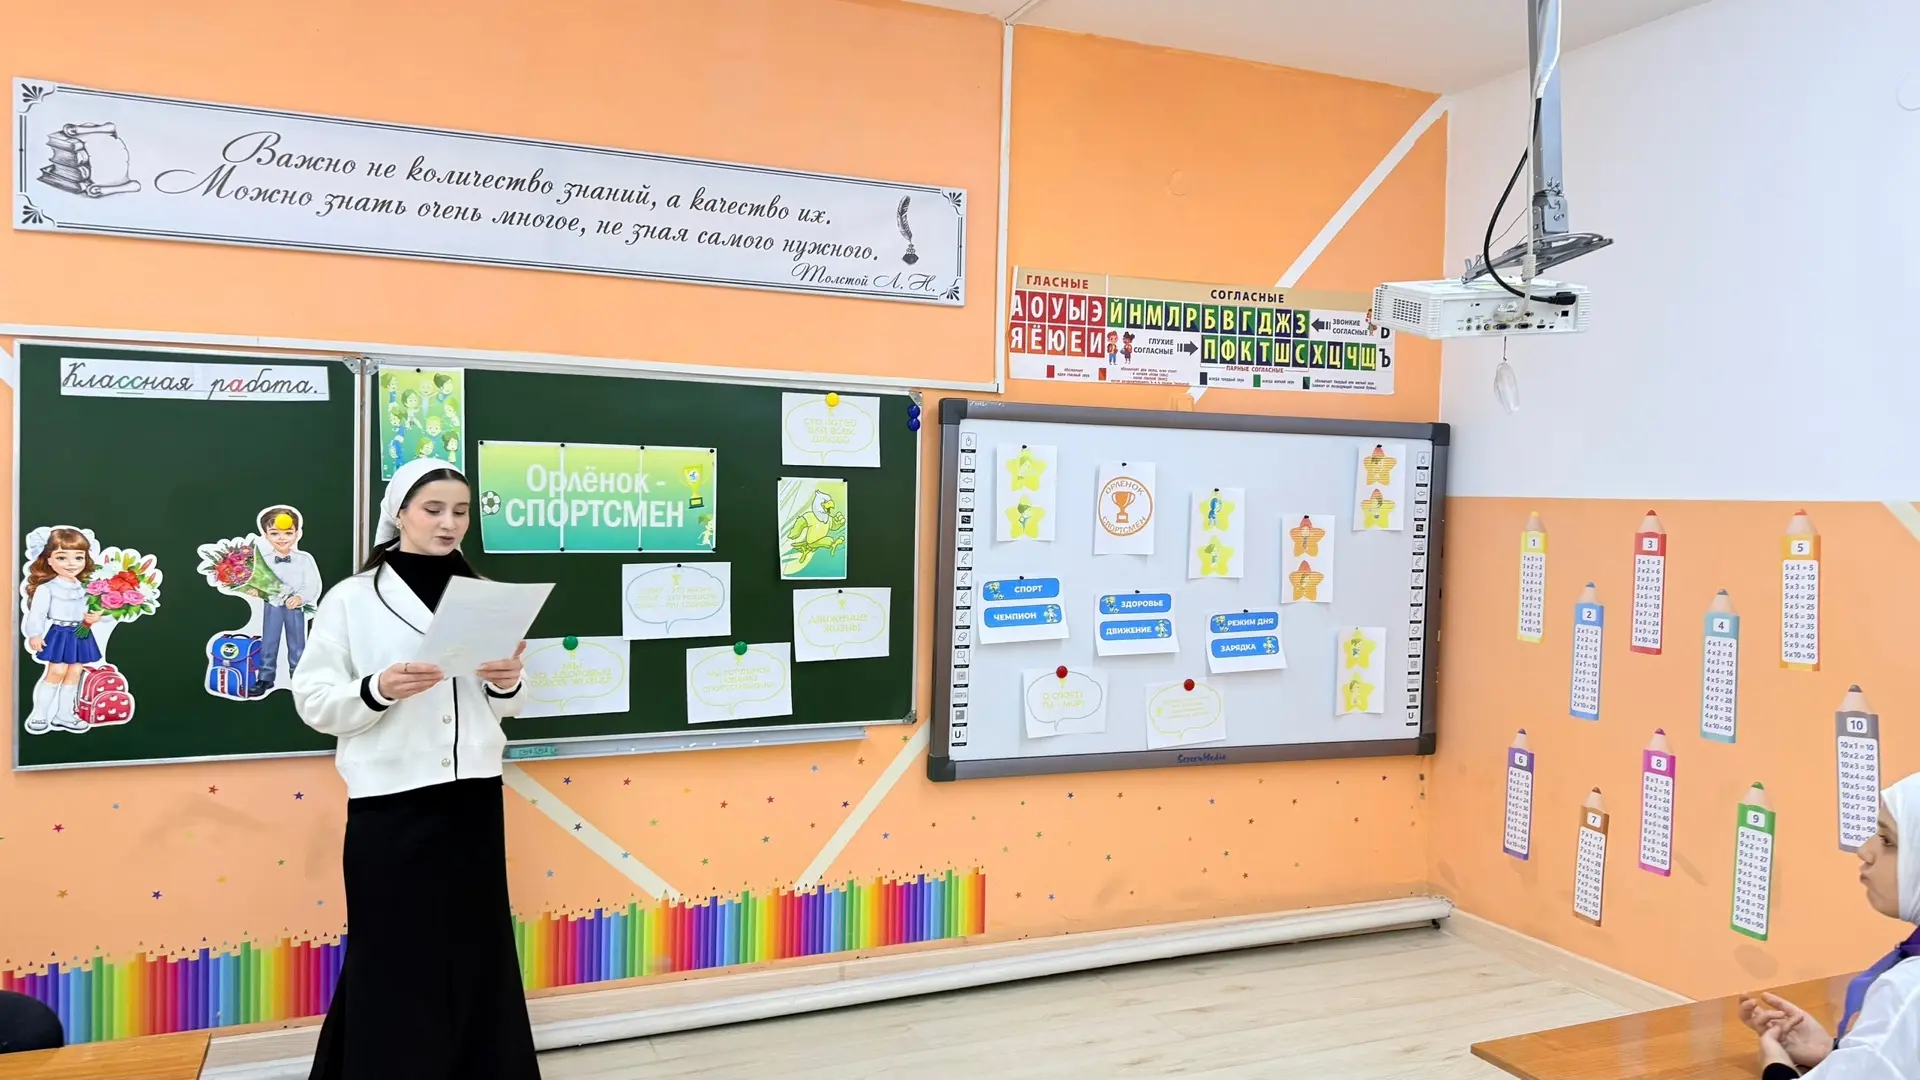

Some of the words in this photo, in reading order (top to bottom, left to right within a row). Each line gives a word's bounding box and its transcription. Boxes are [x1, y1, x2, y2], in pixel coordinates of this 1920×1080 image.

[222, 132, 356, 175] Важно
[366, 159, 397, 179] не
[406, 156, 554, 195] количество
[556, 179, 658, 211] знаний,
[667, 191, 681, 209] а
[690, 186, 790, 221] качество
[798, 206, 832, 226] их.
[154, 163, 313, 207] Можно
[316, 191, 407, 217] знать
[417, 200, 482, 223] очень
[492, 209, 587, 238] многое,
[596, 217, 622, 236] не
[625, 221, 689, 246] зная
[697, 229, 774, 252] самого
[782, 239, 879, 263] нужного.
[791, 262, 869, 288] Толстой
[873, 272, 904, 292] Л.
[908, 272, 936, 293] Н.
[1026, 275, 1089, 290] ГЛАСНЫЕ
[1210, 289, 1285, 304] СОГЛАСНЫЕ
[1332, 318, 1361, 327] ЗВОНКИЕ
[1332, 328, 1368, 336] СОГЛАСНЫЕ
[1148, 338, 1174, 346] ГЛУХИЕ
[1133, 347, 1174, 355] СОГЛАСНЫЕ
[61, 361, 195, 393] Классная
[207, 367, 319, 401] работа.
[526, 464, 650, 498] Орлёнок
[504, 498, 685, 529] СПОРТСМЕН
[1102, 516, 1147, 533] СПОРТСМЕН
[1798, 543, 1804, 552] 5
[1014, 585, 1043, 594] СПОРТ
[1121, 600, 1164, 609] ЗДОРОВЬЕ
[993, 611, 1037, 622] ЧЕМПИОН
[1227, 618, 1256, 627] РЕЖИМ
[1257, 617, 1274, 626] ДНЯ
[1718, 622, 1724, 630] 4
[1106, 626, 1152, 636] ДВИЖЕНИЕ
[1220, 644, 1257, 652] ЗАРЯДКА
[1850, 720, 1863, 730] 10
[1656, 759, 1661, 767] 8
[1753, 815, 1759, 823] 9
